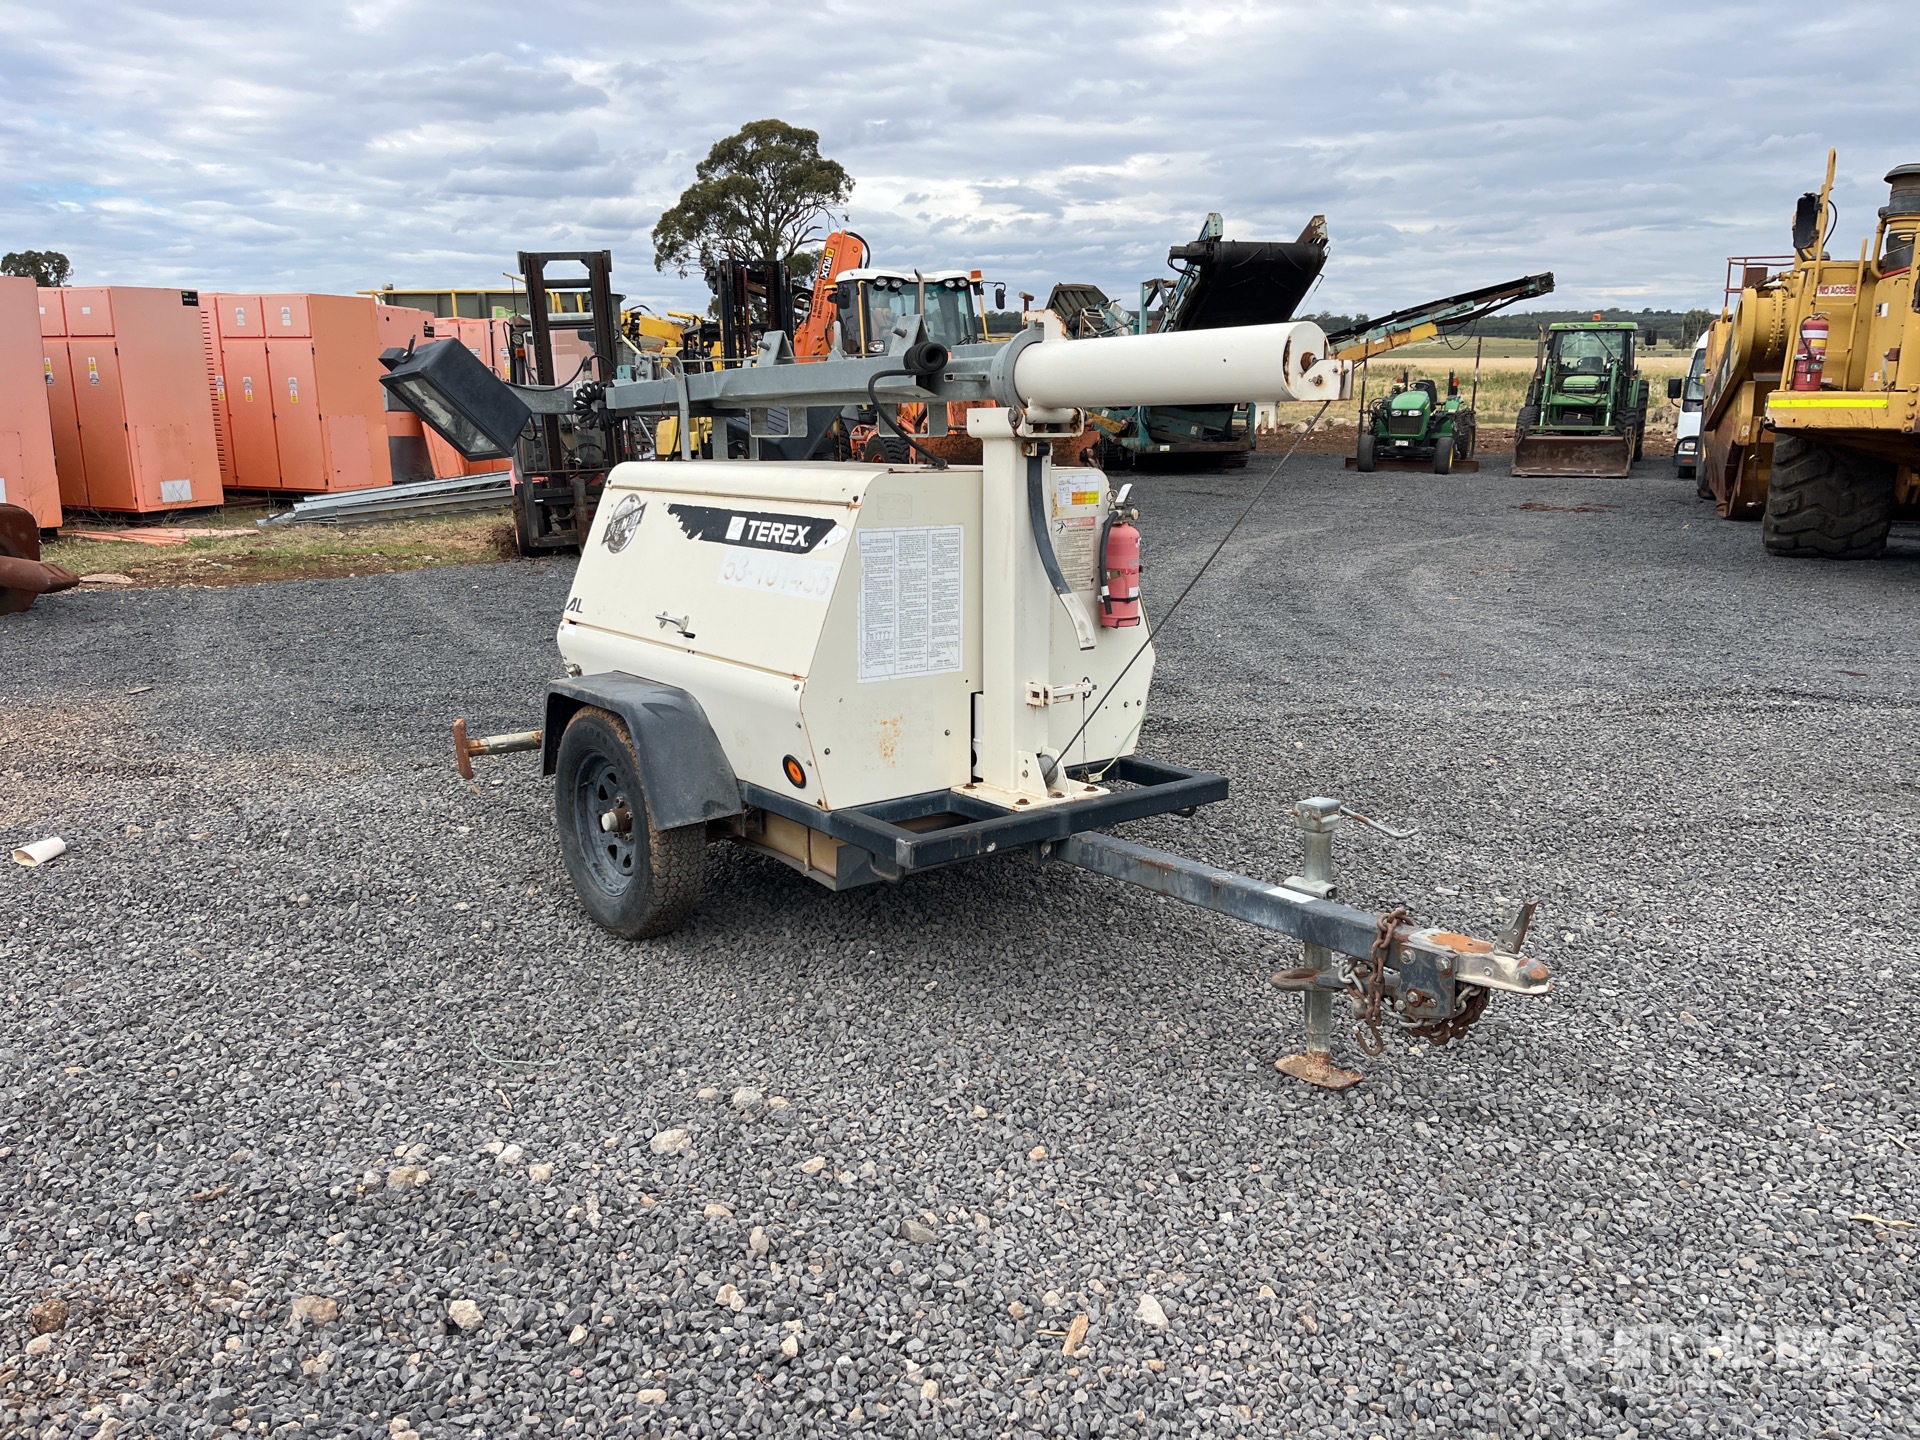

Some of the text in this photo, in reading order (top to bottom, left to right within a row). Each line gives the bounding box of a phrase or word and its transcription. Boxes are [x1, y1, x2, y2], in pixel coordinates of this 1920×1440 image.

[819, 257, 832, 280] 3CX
[1818, 285, 1857, 295] NO ACCESS
[748, 519, 811, 547] TEREX
[566, 596, 583, 613] AL
